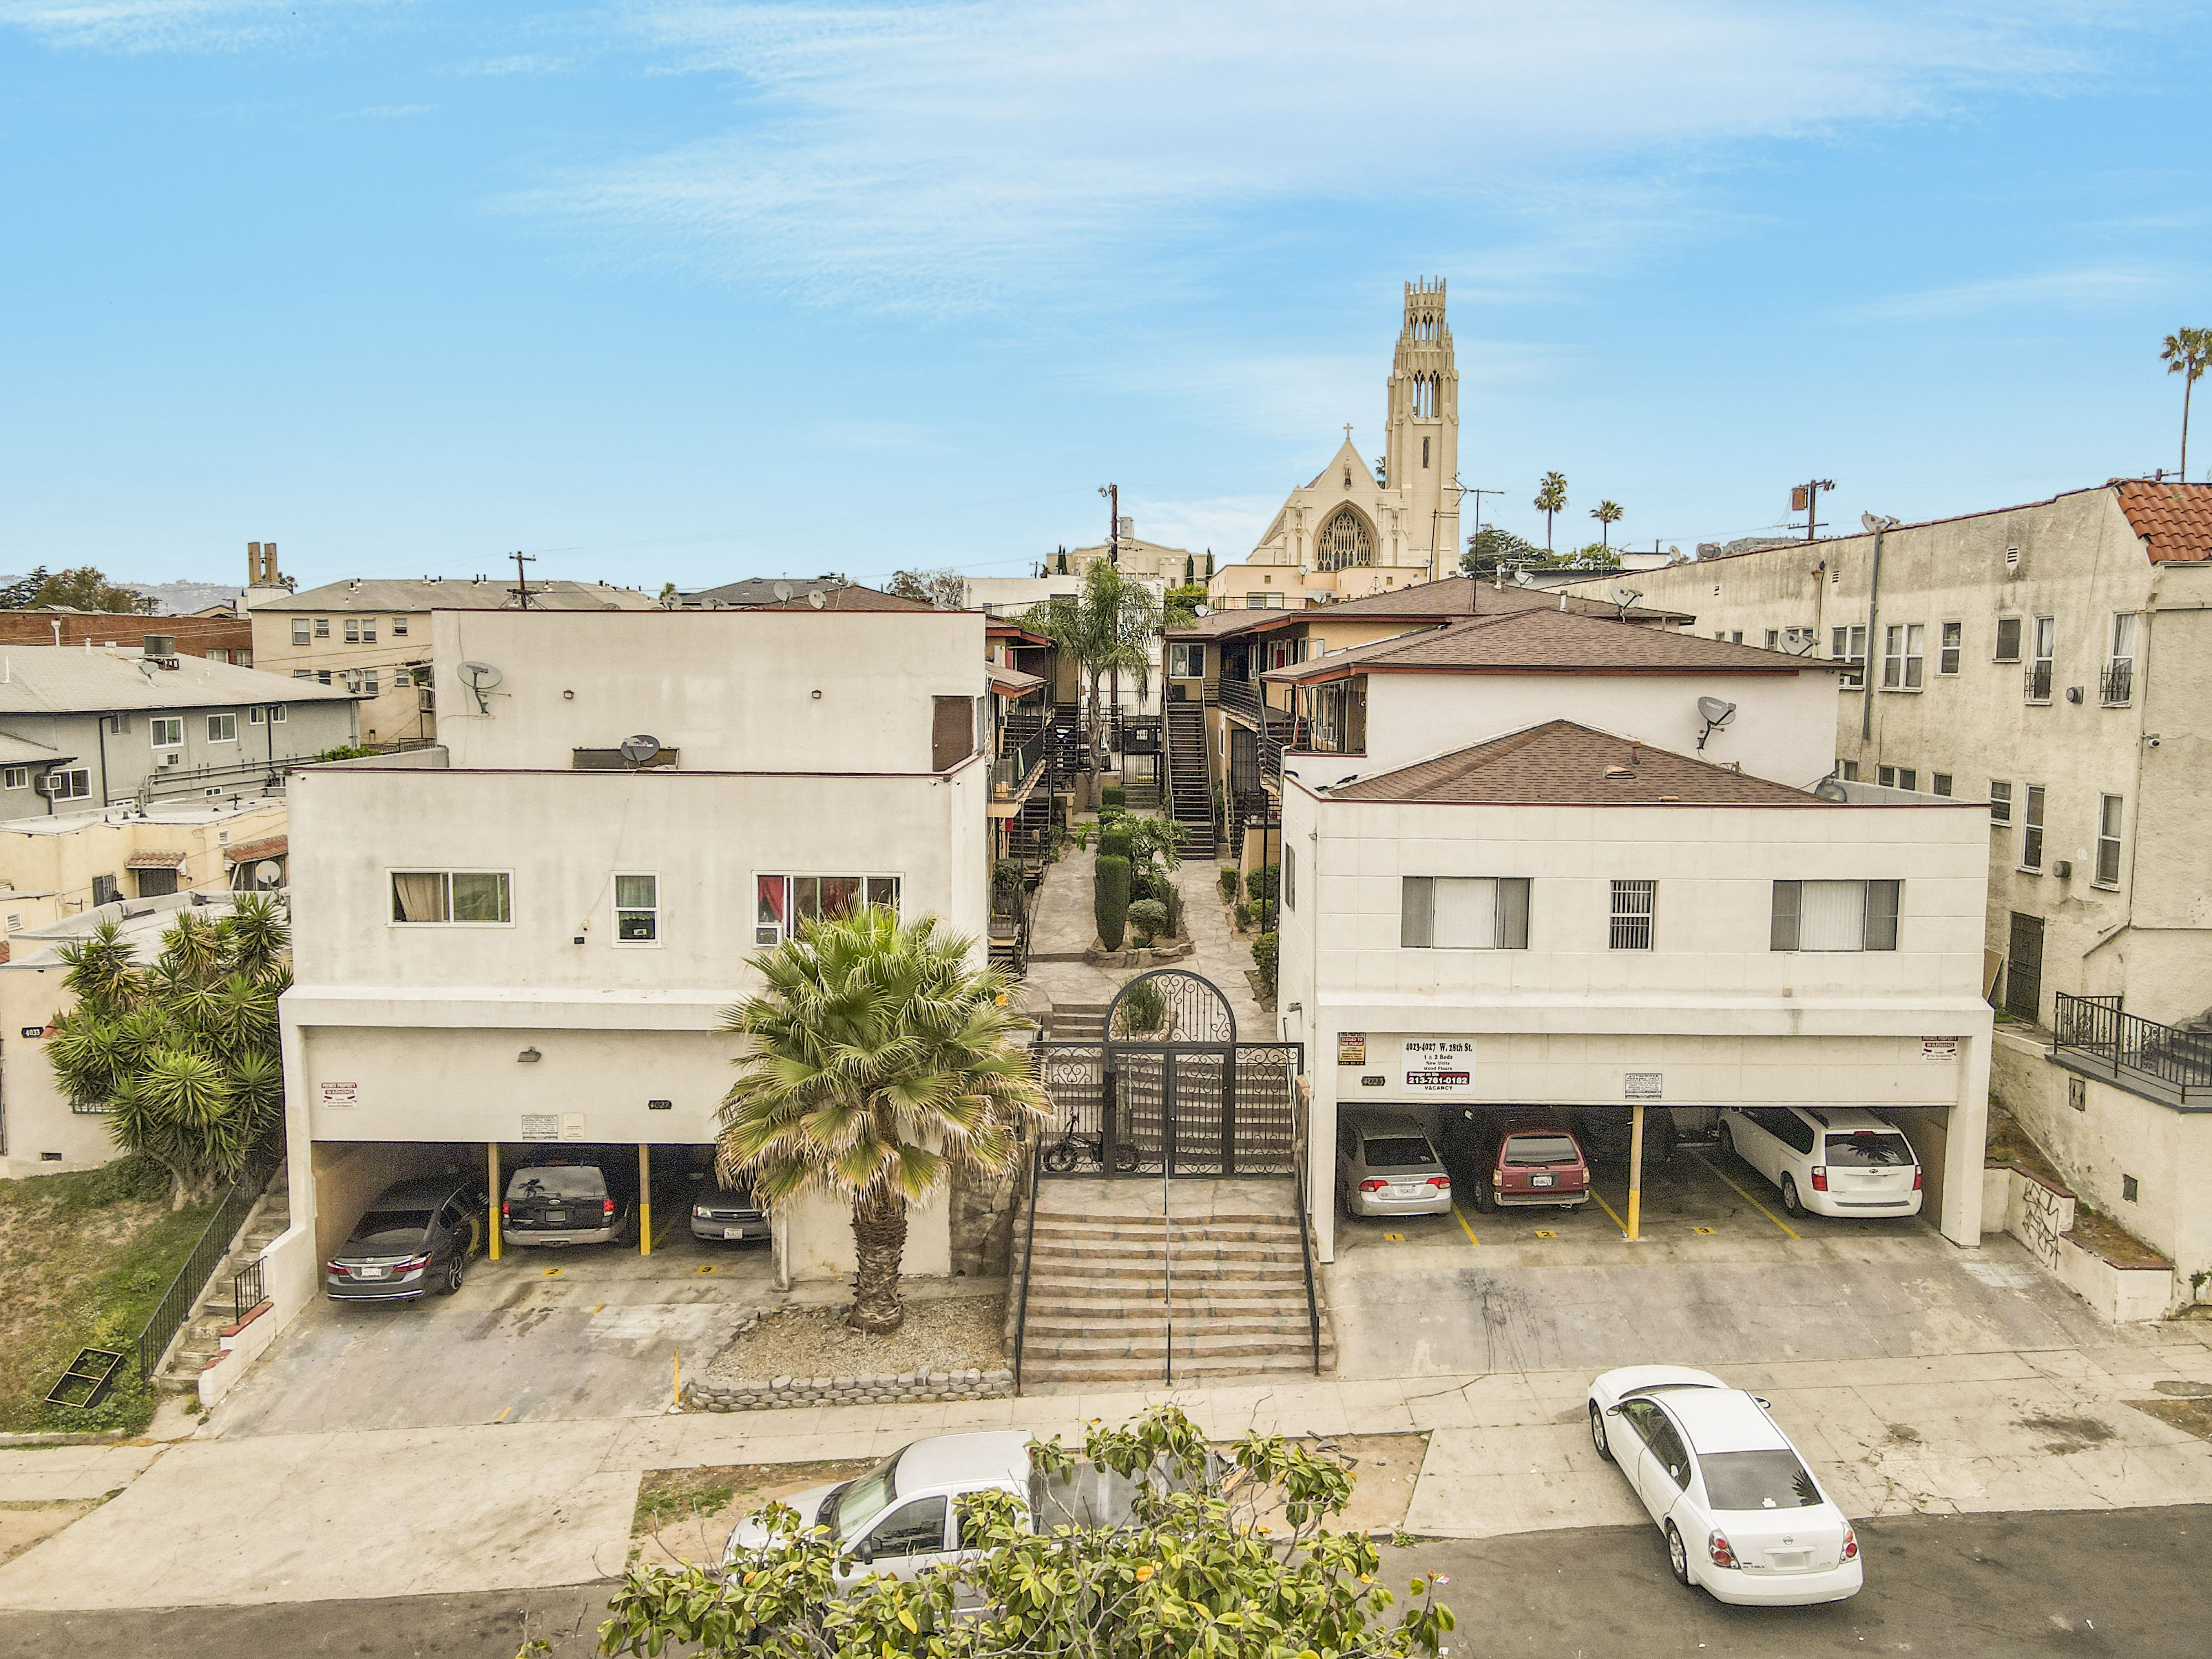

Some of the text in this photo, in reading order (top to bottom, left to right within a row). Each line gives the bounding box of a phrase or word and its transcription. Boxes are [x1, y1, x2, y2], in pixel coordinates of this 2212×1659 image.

[1405, 1042, 1473, 1052] 4023-4027 W. 28th St.
